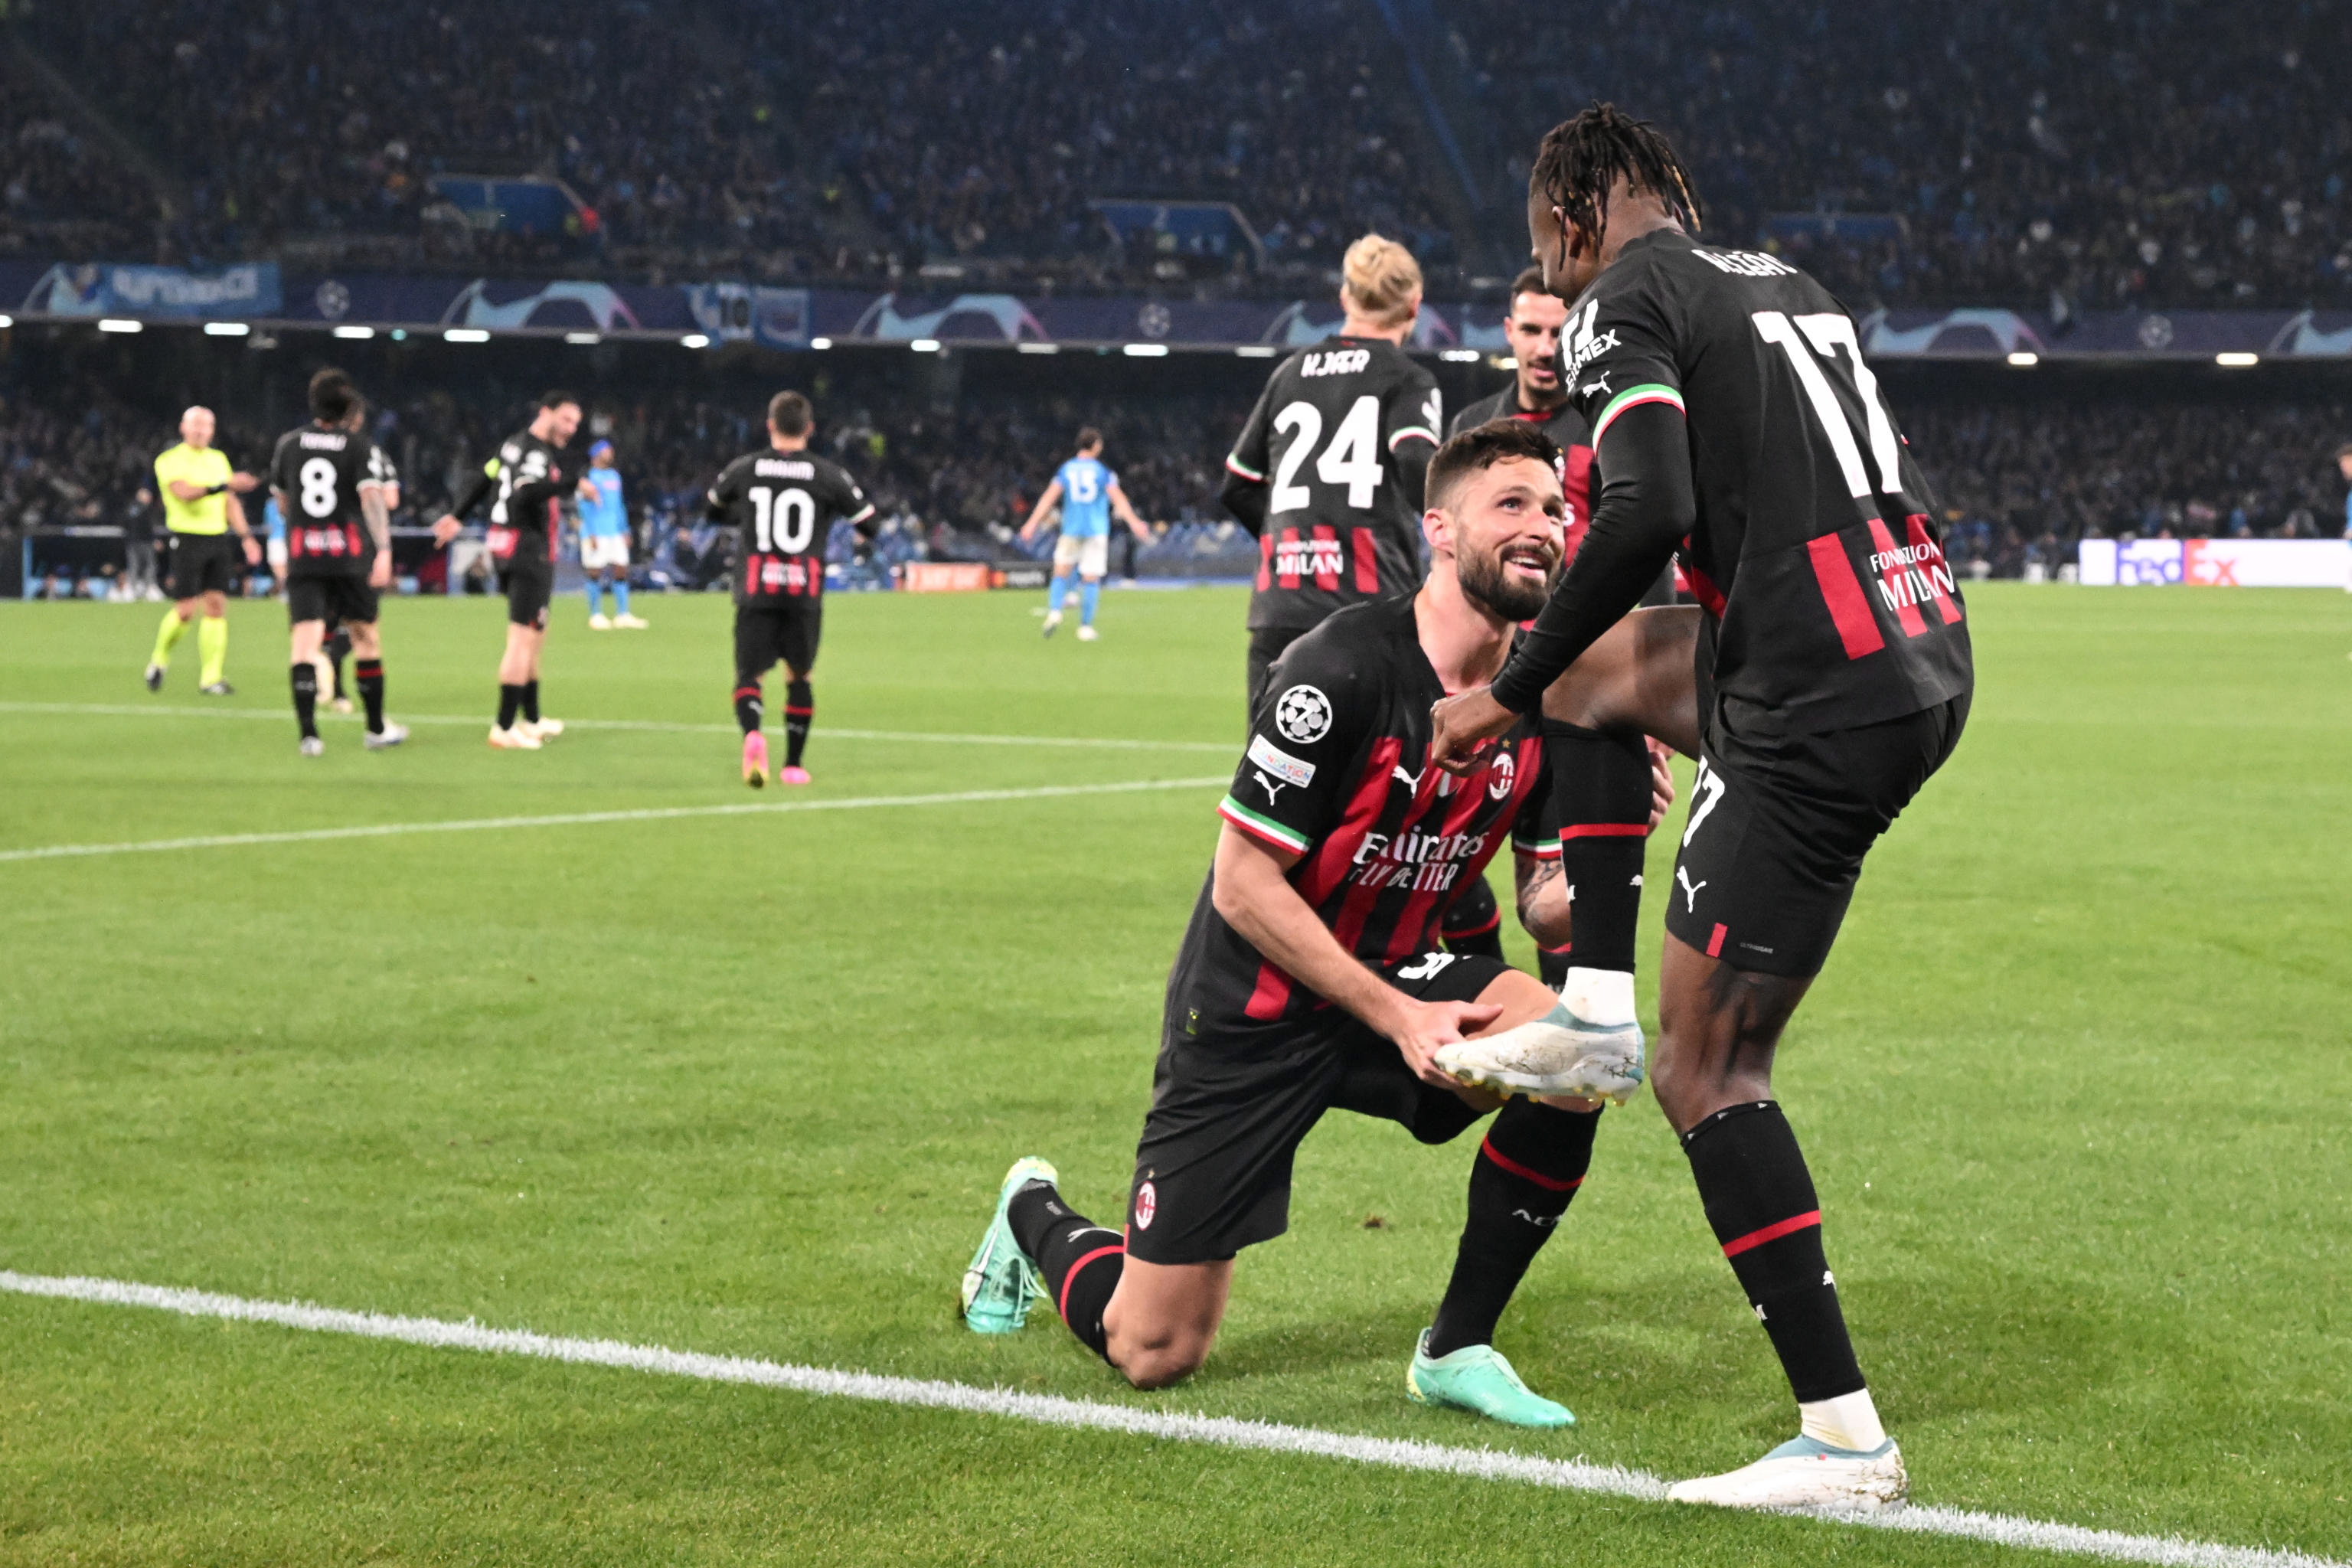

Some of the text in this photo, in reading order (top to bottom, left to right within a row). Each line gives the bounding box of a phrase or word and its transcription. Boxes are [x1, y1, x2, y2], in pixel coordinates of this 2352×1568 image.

[1751, 311, 1903, 498] 17
[1270, 395, 1383, 514] 24
[300, 457, 338, 518] 8
[748, 486, 815, 554] 10
[1276, 553, 1343, 575] MILAN
[1877, 560, 1955, 611] MILAN
